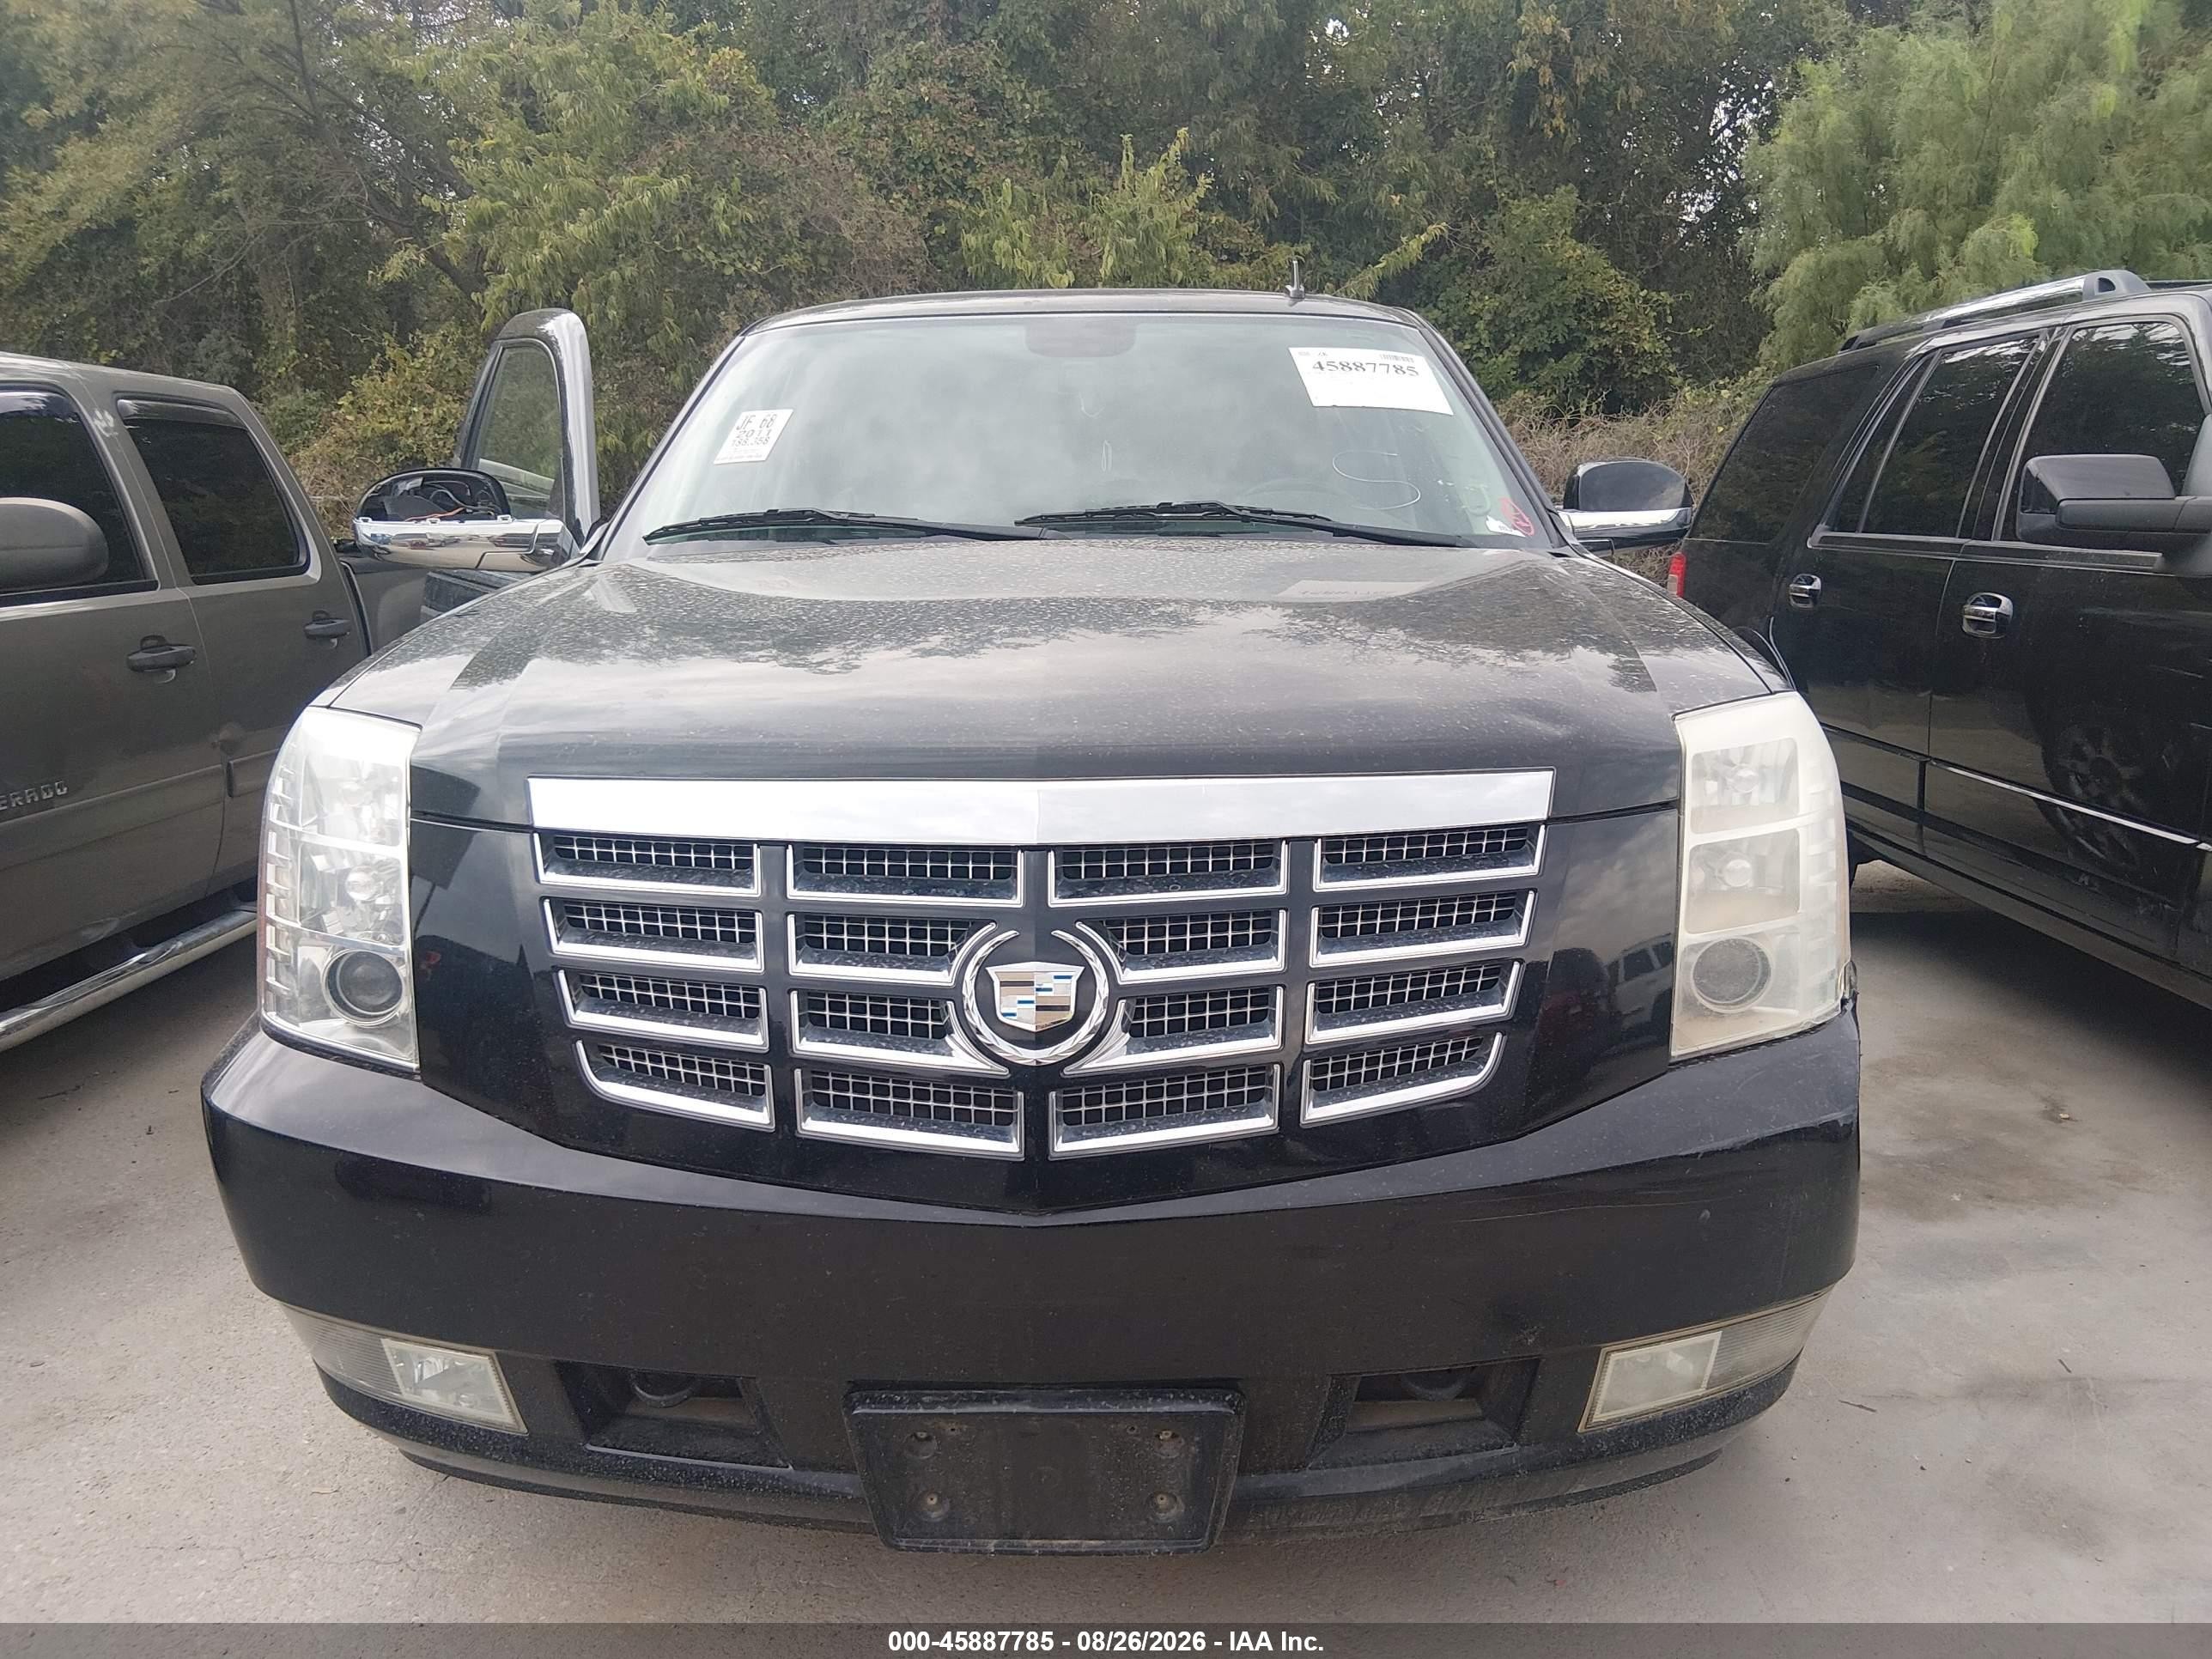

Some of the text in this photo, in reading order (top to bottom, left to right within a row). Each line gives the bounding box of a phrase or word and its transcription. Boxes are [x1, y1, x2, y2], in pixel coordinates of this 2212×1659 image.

[1312, 360, 1419, 377] 45887785
[736, 413, 777, 431] JF 68
[735, 428, 772, 439] 2011
